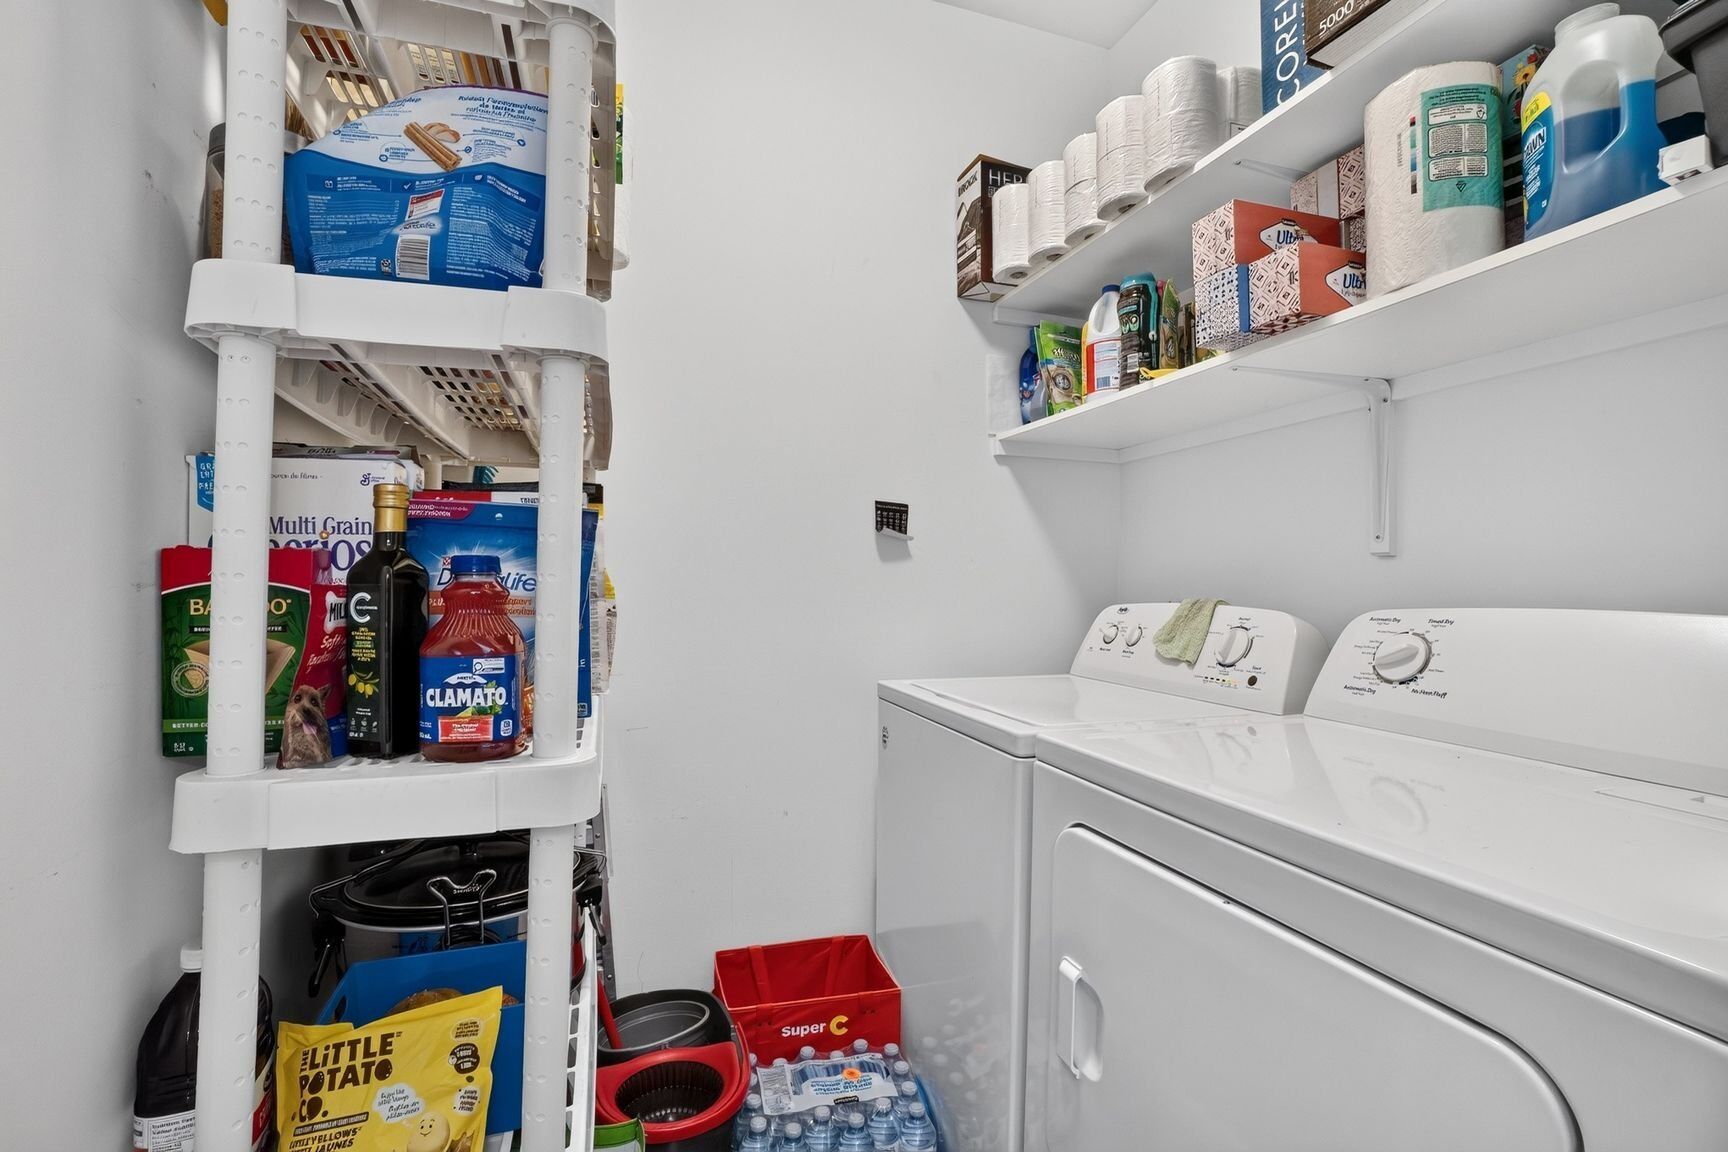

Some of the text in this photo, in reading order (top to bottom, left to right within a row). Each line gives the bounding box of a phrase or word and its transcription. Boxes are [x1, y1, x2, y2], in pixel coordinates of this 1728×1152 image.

[1319, 0, 1354, 36] 5000
[269, 516, 373, 535] Multi Grain
[426, 686, 507, 708] CLAMATO
[781, 1015, 848, 1037] super C
[300, 1049, 310, 1074] THE
[299, 1058, 393, 1098] POTATO
[311, 1128, 358, 1145] YELLOWS
